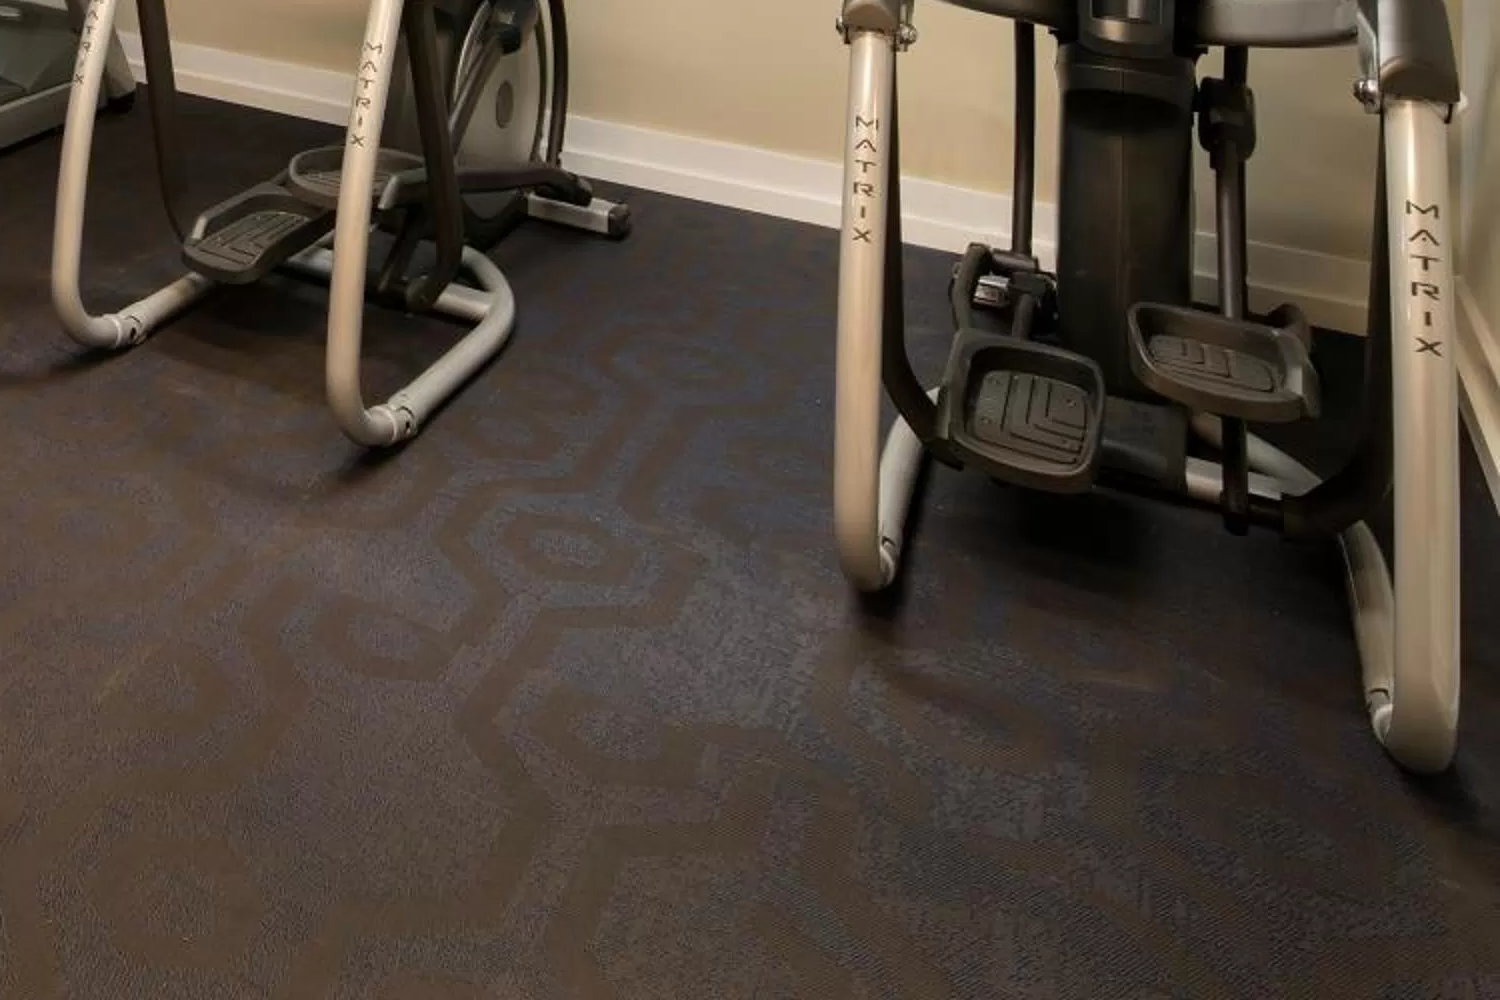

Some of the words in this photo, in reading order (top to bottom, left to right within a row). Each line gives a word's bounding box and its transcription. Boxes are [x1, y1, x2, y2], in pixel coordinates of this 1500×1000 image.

[350, 40, 383, 149] MATRIX
[852, 114, 879, 244] MATRIX
[1405, 200, 1444, 358] MATRIX
